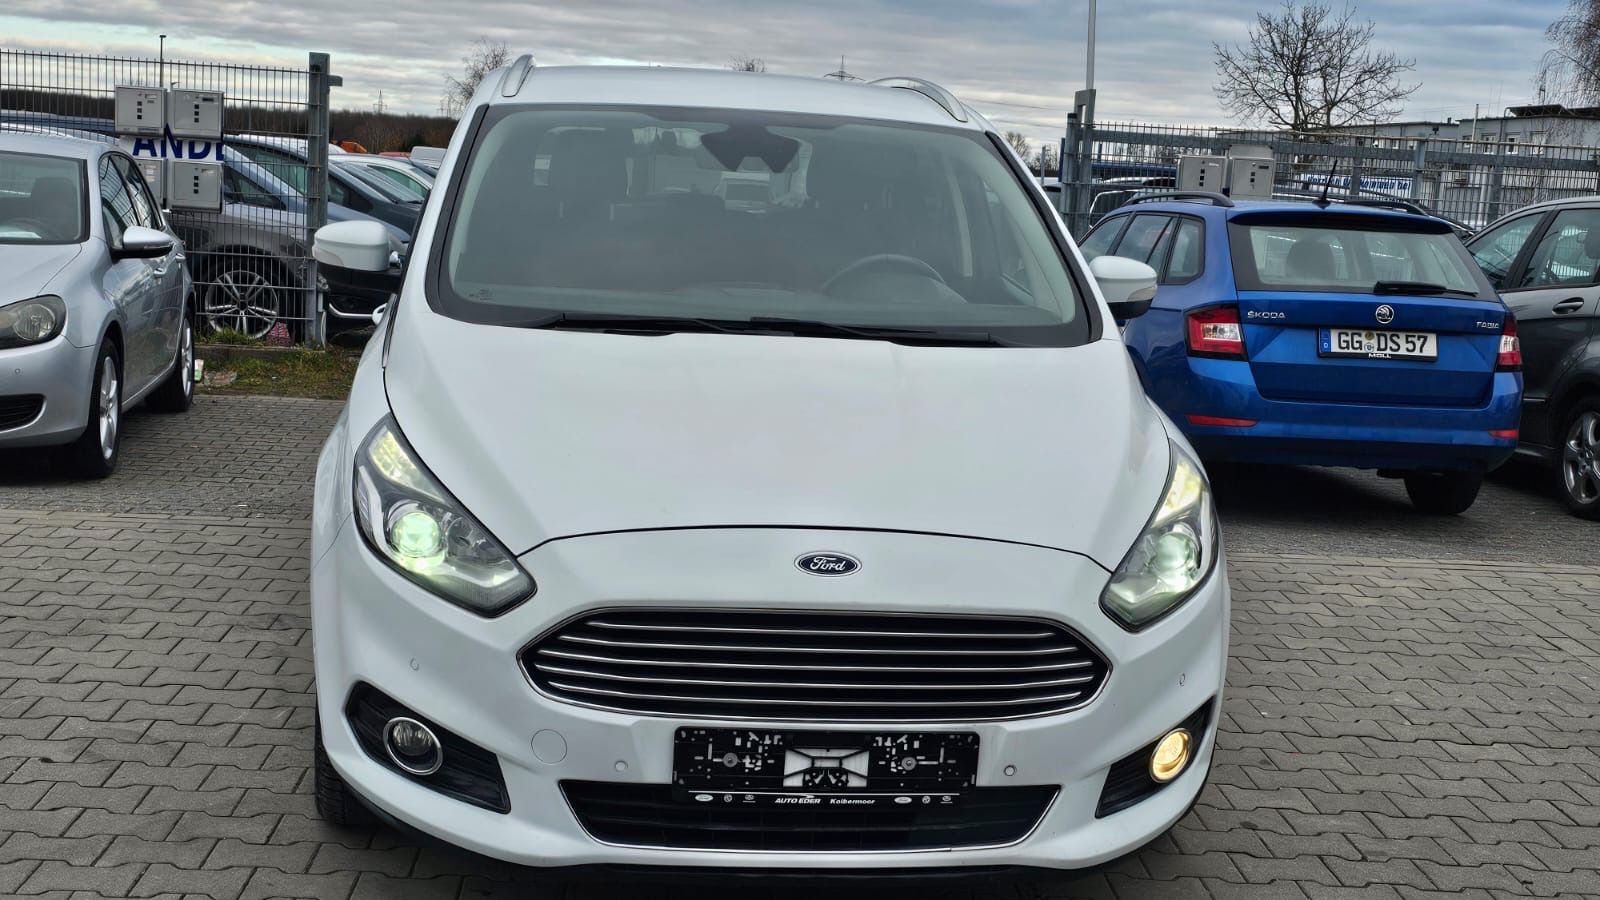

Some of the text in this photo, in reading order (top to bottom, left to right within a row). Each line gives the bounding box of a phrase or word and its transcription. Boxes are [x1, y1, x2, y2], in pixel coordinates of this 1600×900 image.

[1337, 331, 1362, 351] GG
[1376, 332, 1401, 353] DS
[1405, 334, 1428, 354] 57
[810, 556, 846, 570] Ford
